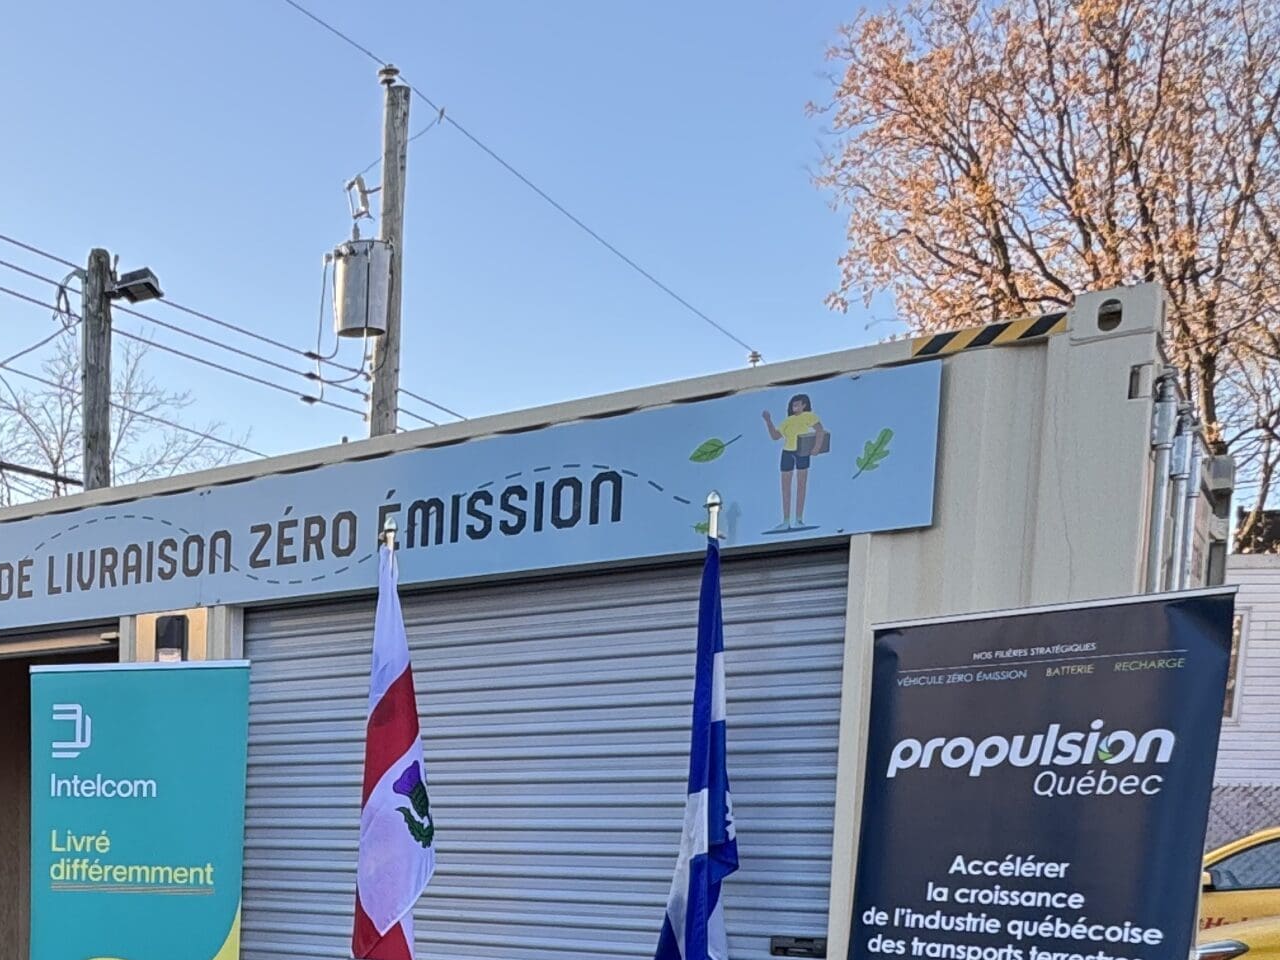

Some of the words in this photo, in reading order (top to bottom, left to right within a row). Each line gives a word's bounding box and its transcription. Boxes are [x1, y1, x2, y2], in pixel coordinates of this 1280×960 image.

[47, 529, 232, 595] LIVRAISON
[249, 505, 357, 569] ZÉRO
[377, 470, 623, 552] ÉMISSION
[972, 651, 994, 661] NOS
[994, 648, 1029, 660] FILIÈRES
[1030, 641, 1097, 657] STRATÉGIQUES
[897, 670, 944, 688] VÉHICULE
[945, 668, 974, 684] ZÉRO
[976, 668, 1028, 683] ÉMISSION
[1045, 662, 1096, 678] BATTERIE
[1113, 656, 1186, 673] RECHARGE
[886, 718, 1176, 778] propulsion
[50, 773, 157, 798] Intelcom
[1033, 768, 1163, 798] Québec
[51, 829, 111, 853] Livré
[50, 858, 215, 885] différemment
[948, 854, 1070, 879] Accélérer
[926, 881, 949, 903] la
[954, 884, 1086, 910] croissance
[862, 906, 889, 927] de
[893, 907, 1002, 935] l'industrie
[1006, 915, 1164, 946] québécoise
[867, 934, 906, 955] des
